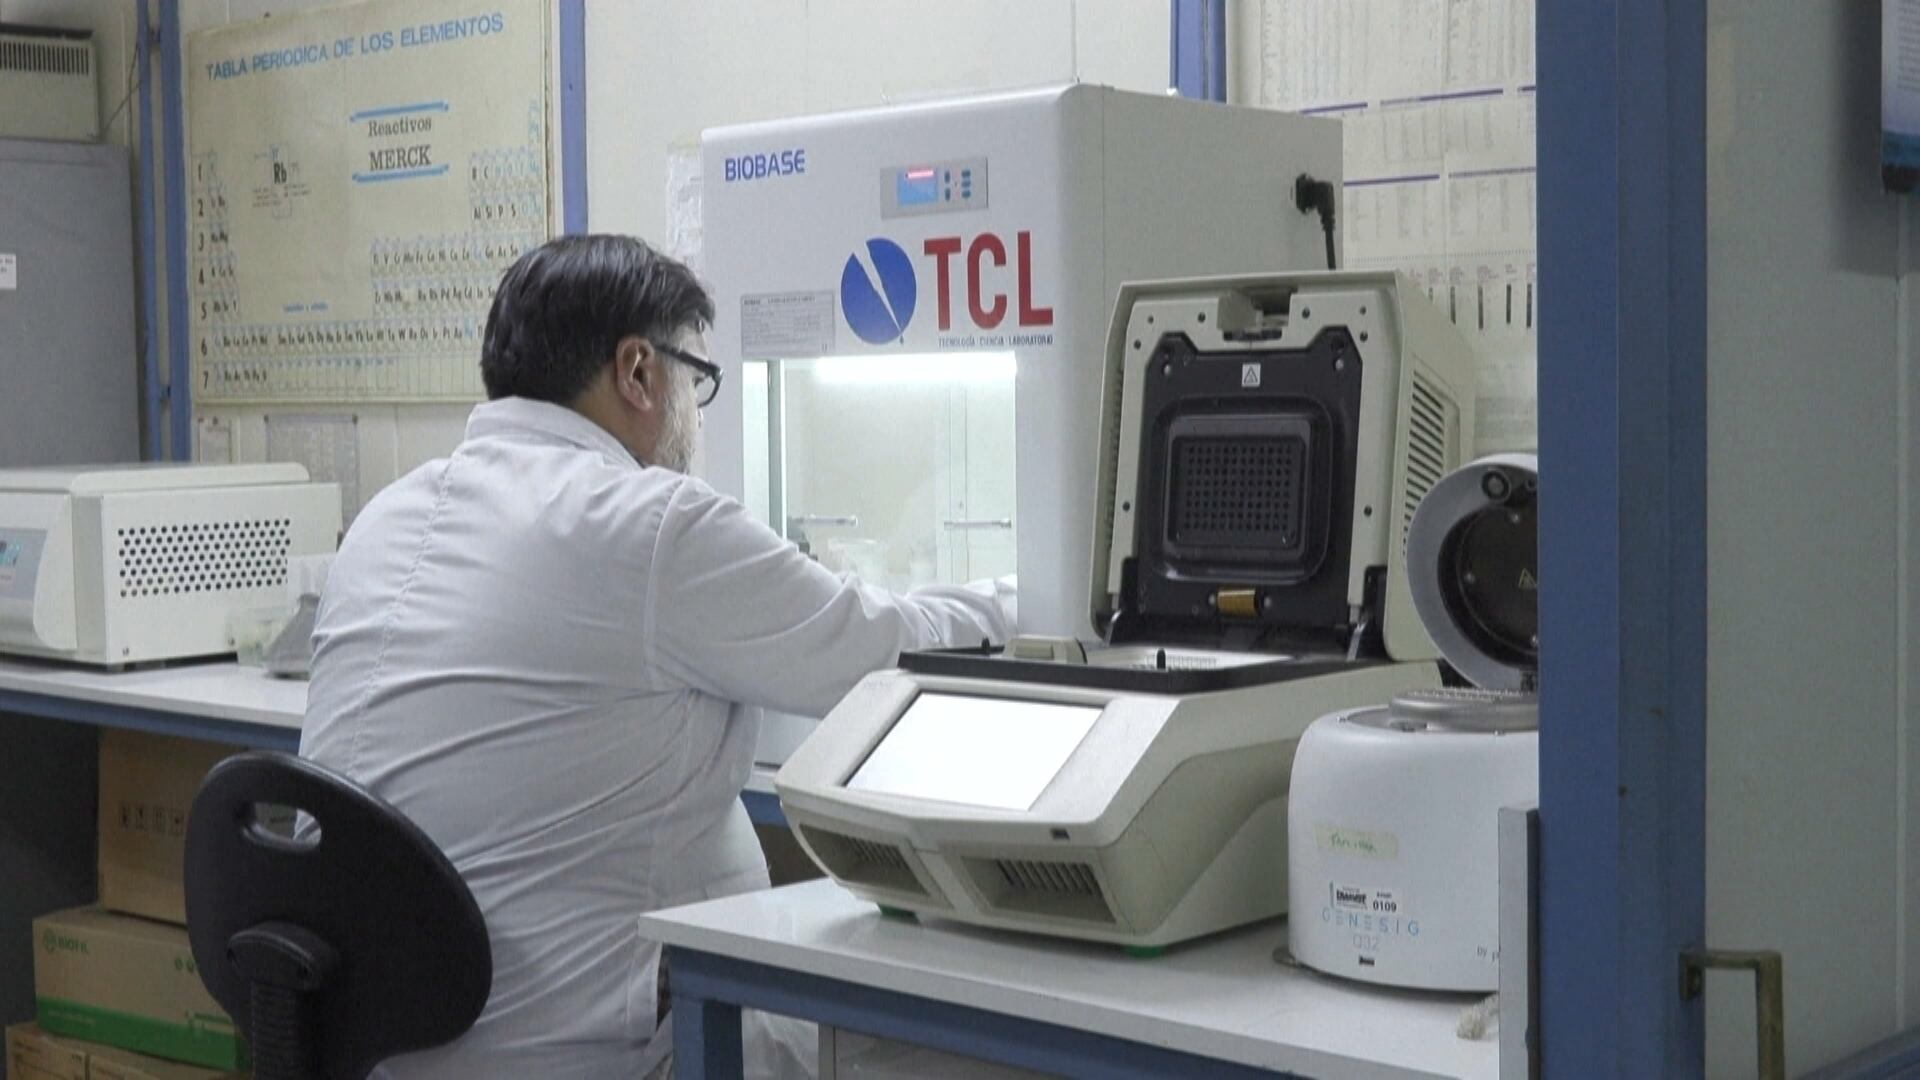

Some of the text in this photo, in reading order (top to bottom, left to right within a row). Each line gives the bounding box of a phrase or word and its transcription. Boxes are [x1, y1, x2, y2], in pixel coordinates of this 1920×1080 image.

[205, 13, 504, 80] TABLA PERIODICA DE LOS ELEMENTOS
[368, 117, 432, 137] Reactivos
[369, 145, 432, 171] MERCK
[725, 149, 805, 182] BIOBASE
[273, 162, 287, 184] Rb
[197, 198, 204, 217] 2
[198, 232, 204, 252] 3
[924, 230, 1053, 332] TCL
[201, 302, 207, 320] 5
[201, 338, 207, 356] 6
[203, 370, 209, 389] 7
[1373, 900, 1397, 913] 0109
